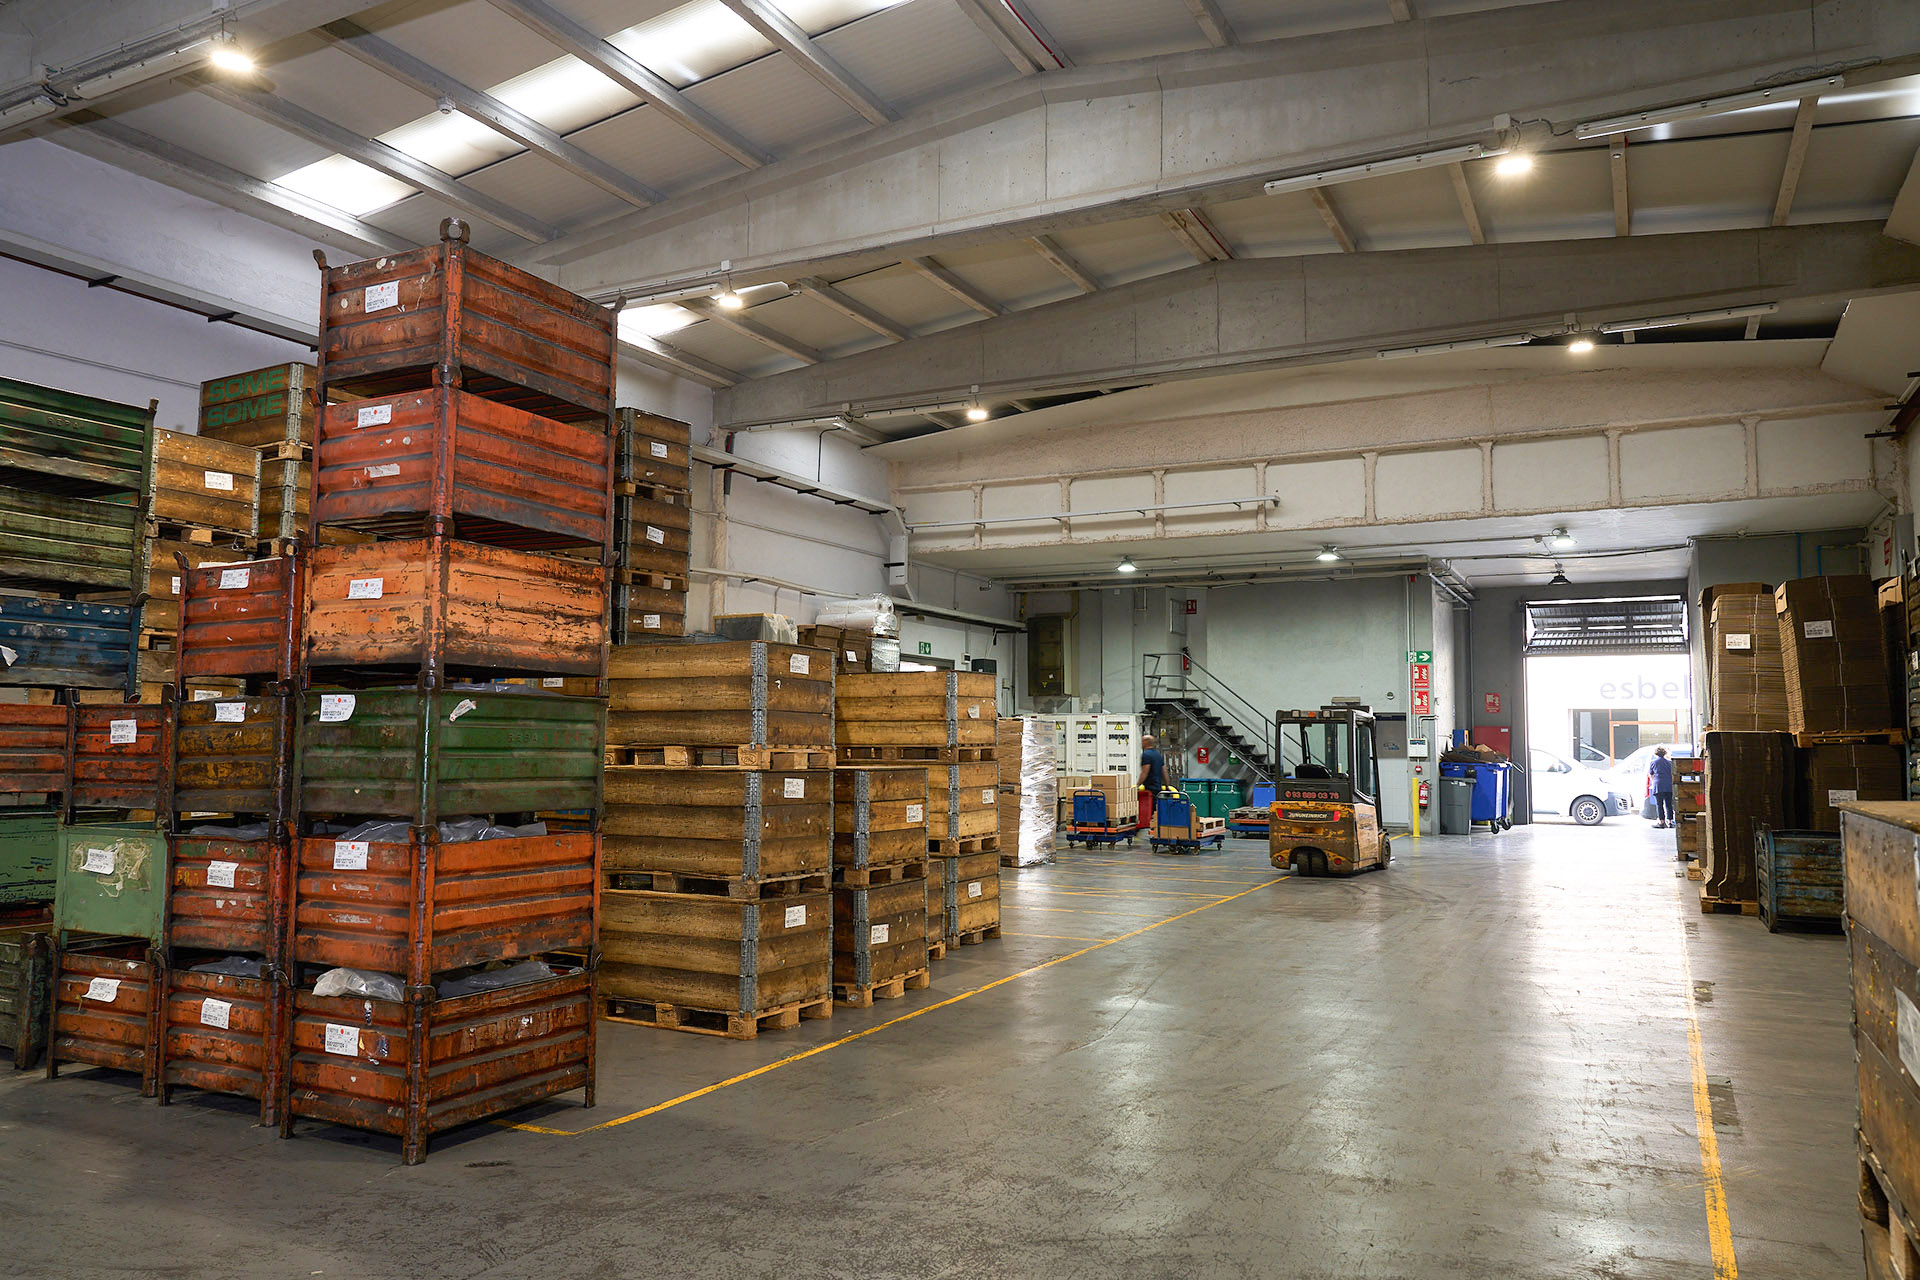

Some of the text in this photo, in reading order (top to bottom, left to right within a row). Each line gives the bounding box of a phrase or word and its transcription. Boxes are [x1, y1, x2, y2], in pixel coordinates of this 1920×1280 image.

[208, 368, 284, 403] SOME
[207, 393, 283, 427] SOME
[1600, 674, 1689, 700] esbel
